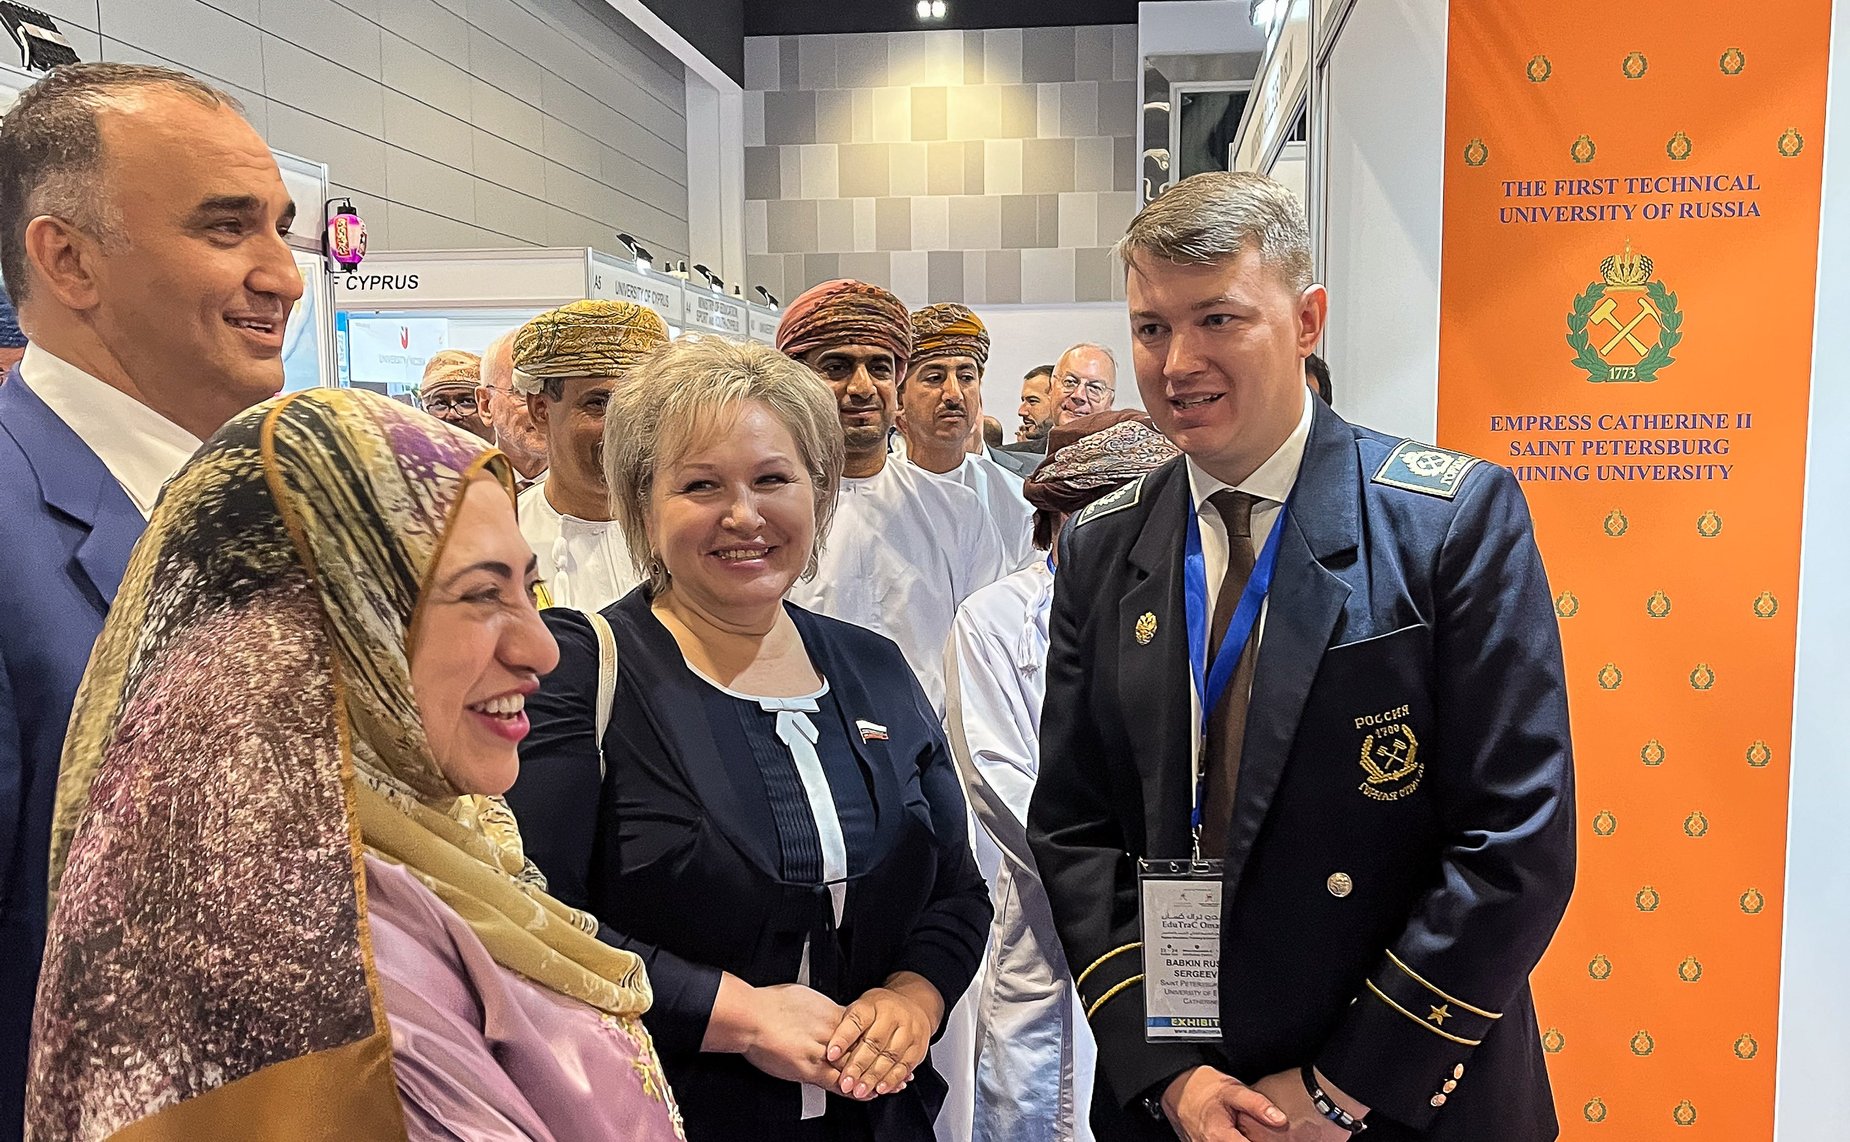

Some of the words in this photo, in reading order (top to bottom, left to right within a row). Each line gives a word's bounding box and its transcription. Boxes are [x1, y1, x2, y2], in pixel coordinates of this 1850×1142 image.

[1502, 180, 1548, 197] THE
[1554, 178, 1619, 196] FIRST
[1624, 174, 1761, 194] TECHNICAL
[1499, 204, 1637, 224] UNIVERSITY
[1642, 203, 1674, 220] OF
[1678, 201, 1762, 219] RUSSIA
[346, 275, 419, 290] CYPRUS
[1608, 366, 1637, 380] 1773
[1490, 415, 1592, 432] EMPRESS
[1597, 413, 1730, 431] CATHERINE
[1736, 413, 1752, 429] II
[1509, 440, 1576, 457] SAINT
[1581, 438, 1730, 456] PETERSBURG
[1506, 465, 1590, 482] MINING
[1597, 464, 1734, 481] UNIVERSITY
[1354, 704, 1410, 729] РОССИЯ
[1375, 724, 1400, 739] 1700
[1162, 921, 1199, 929] EduTraC
[1166, 959, 1201, 967] BABKIN
[1174, 970, 1218, 978] SERGEEV
[1171, 1018, 1220, 1027] EXHIBIT
